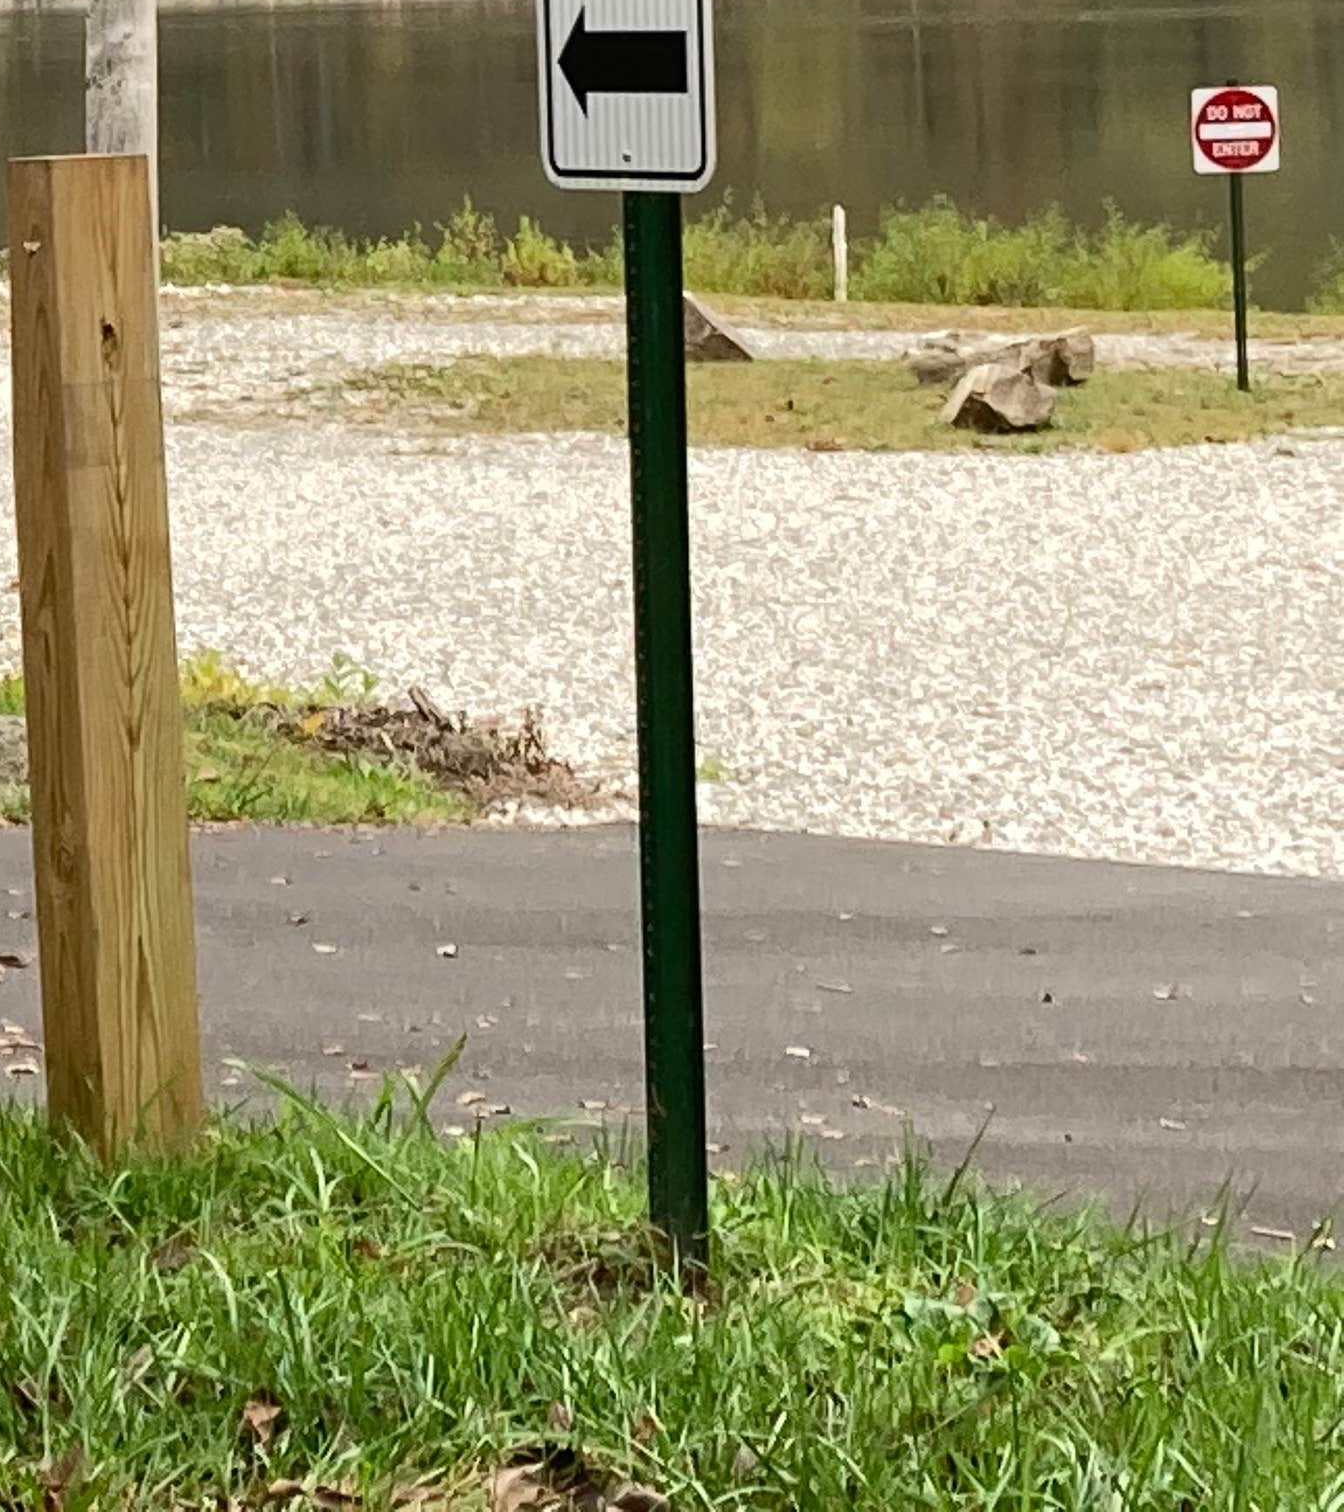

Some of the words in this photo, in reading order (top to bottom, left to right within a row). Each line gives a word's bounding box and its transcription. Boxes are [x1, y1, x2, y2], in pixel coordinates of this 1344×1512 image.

[1206, 105, 1228, 120] DO
[1232, 103, 1263, 119] NOT
[1212, 141, 1259, 157] ENTER
